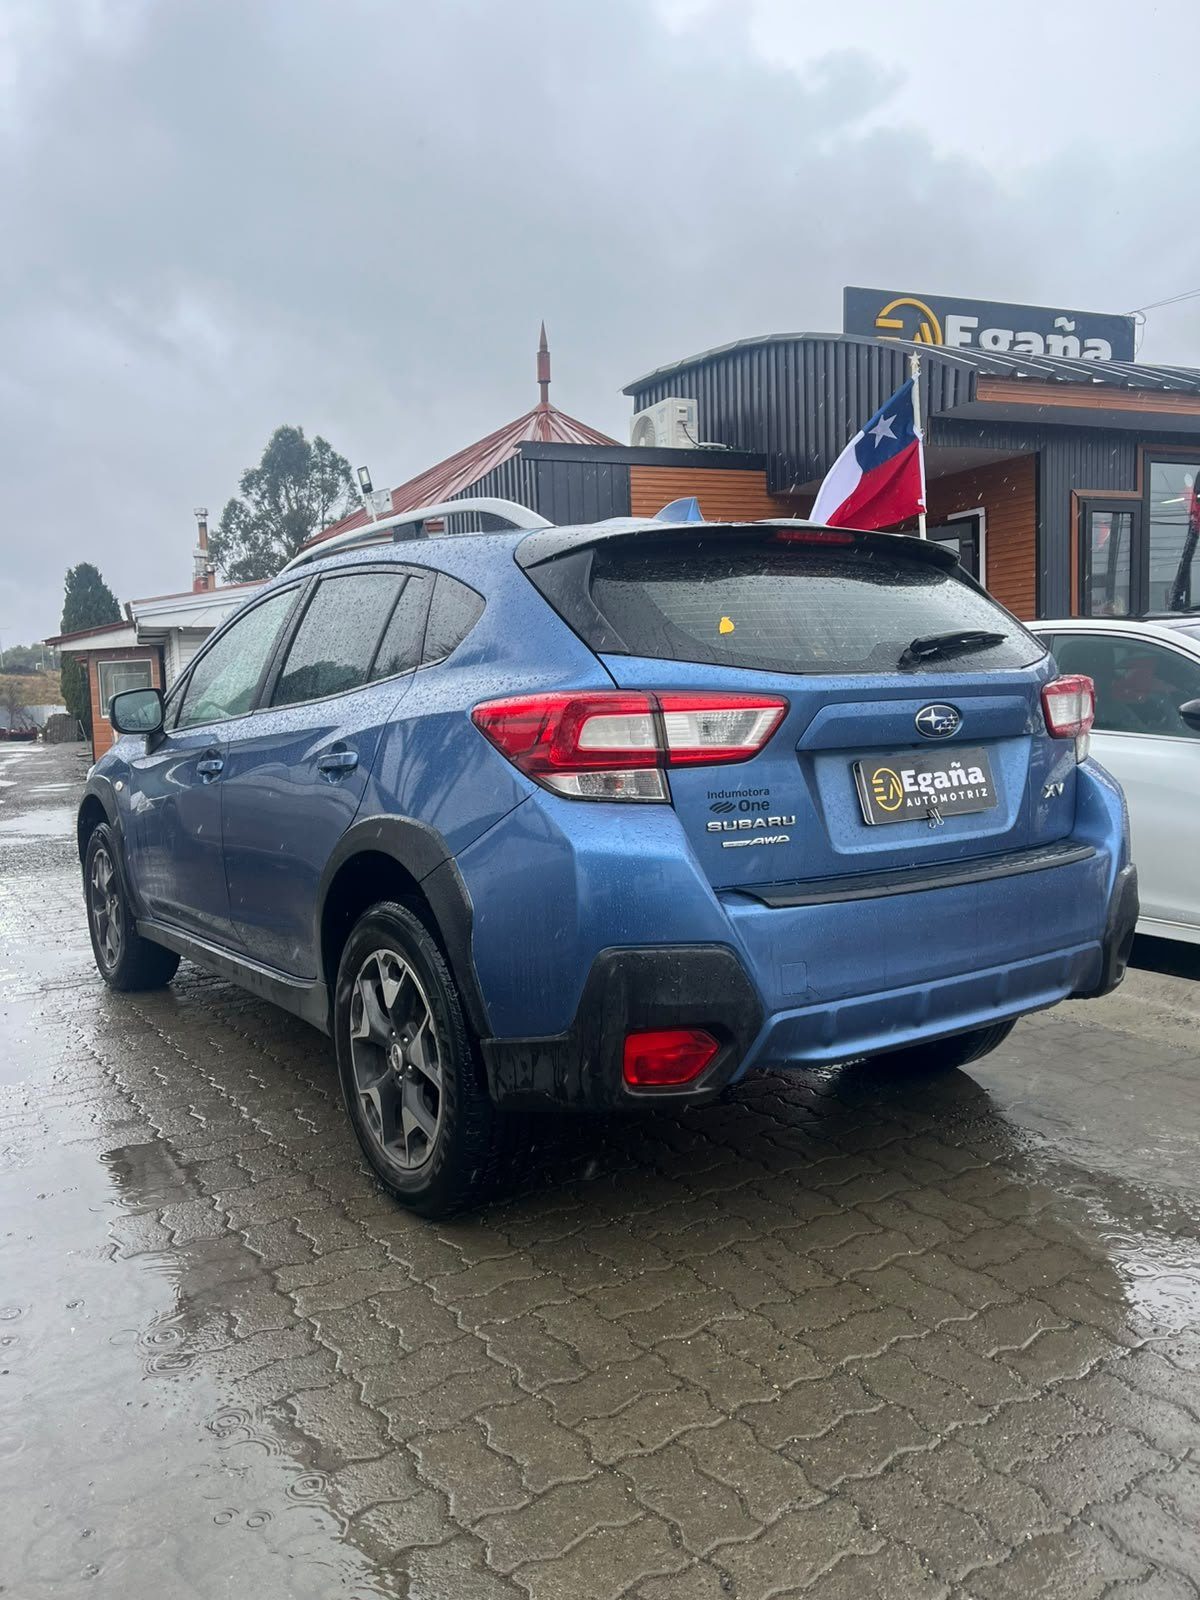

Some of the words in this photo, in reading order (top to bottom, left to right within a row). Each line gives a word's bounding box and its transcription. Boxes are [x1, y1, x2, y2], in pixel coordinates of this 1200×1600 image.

[900, 762, 986, 795] Egaña
[707, 788, 770, 800] Indumotora
[906, 788, 989, 808] AUTOMOTRIZ
[1043, 782, 1065, 799] XV
[738, 799, 770, 812] One
[707, 815, 796, 832] SUBARU
[750, 835, 791, 846] AWD
